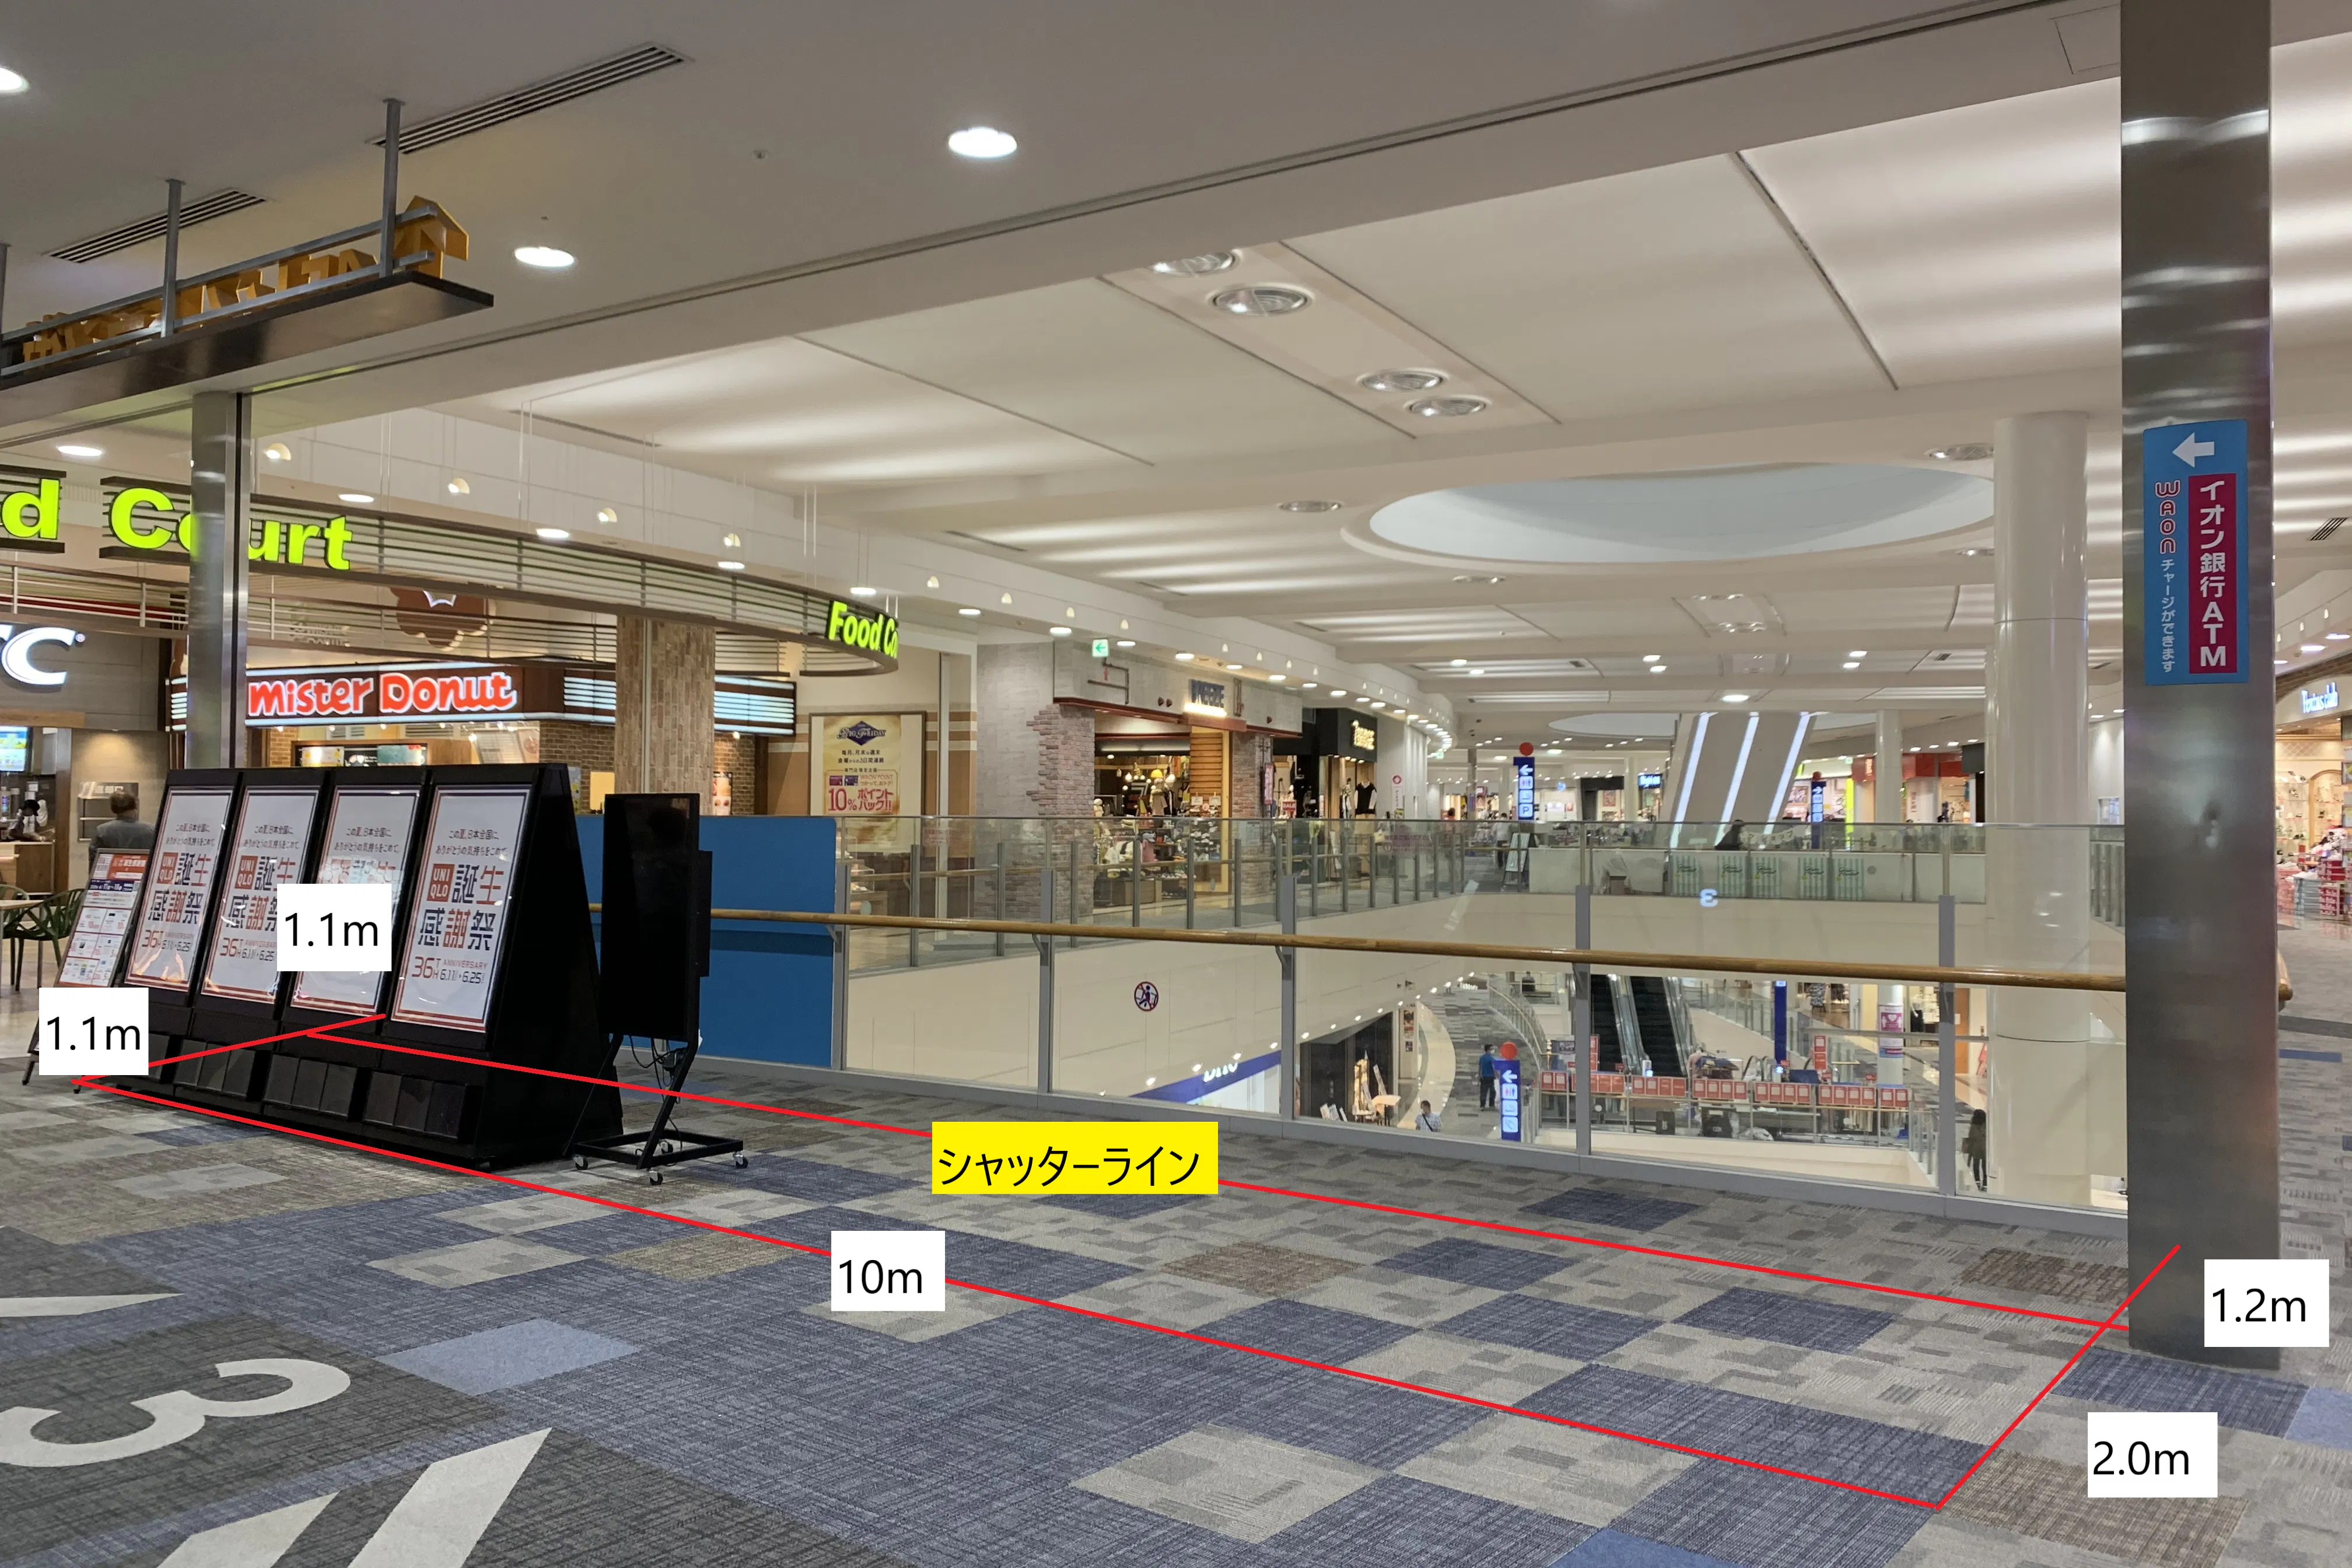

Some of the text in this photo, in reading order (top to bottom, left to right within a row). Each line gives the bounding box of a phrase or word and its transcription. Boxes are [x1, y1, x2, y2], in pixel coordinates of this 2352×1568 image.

[2155, 480, 2180, 555] WAON
[2200, 481, 2226, 667] イオン銀行ATM
[829, 600, 884, 650] Food
[2161, 559, 2176, 673] チャージができます
[159, 869, 173, 881] QLO
[162, 856, 174, 867] UNI
[240, 860, 255, 872] UNI
[433, 868, 450, 882] UNI
[237, 874, 253, 886] QLO
[430, 884, 449, 899] QLO
[451, 864, 504, 905] 誕生
[418, 908, 496, 951] 感謝祭
